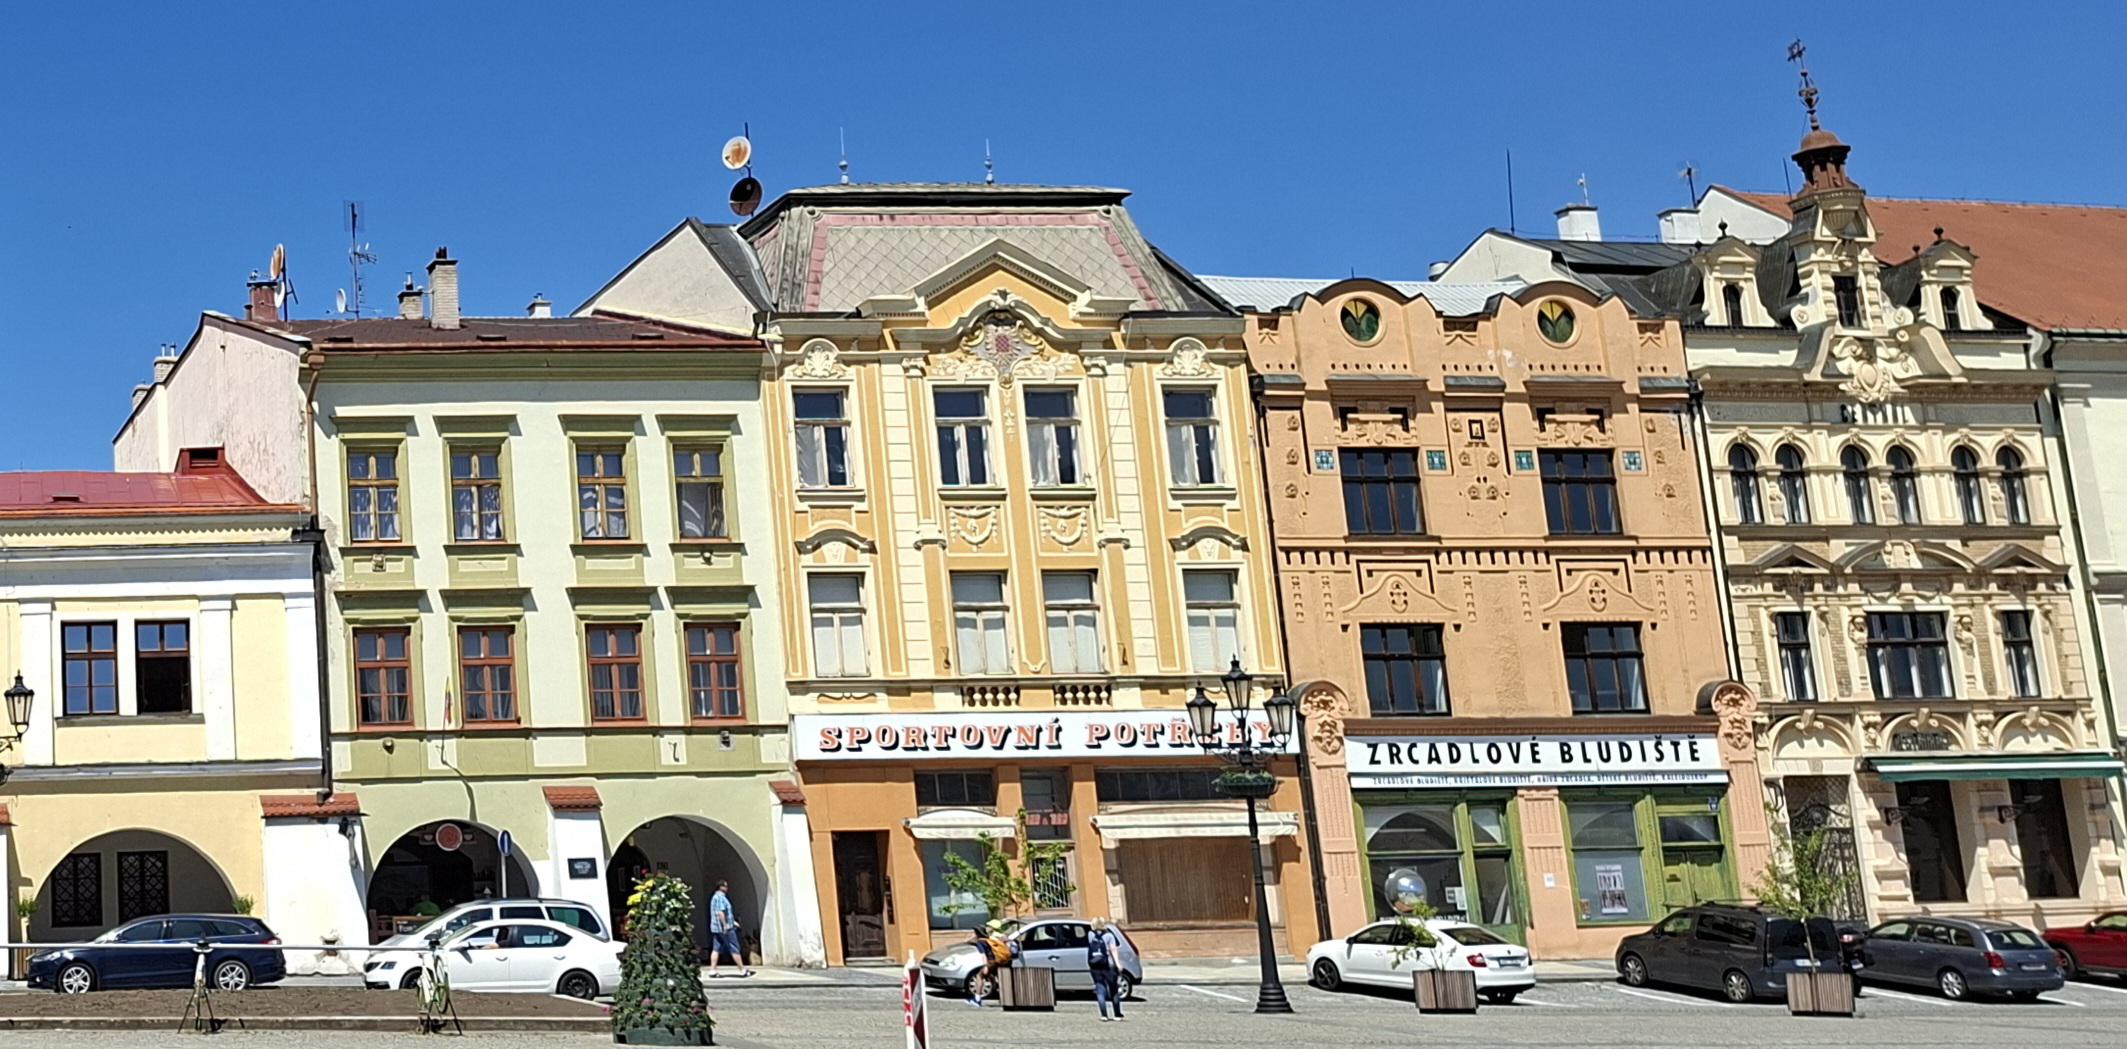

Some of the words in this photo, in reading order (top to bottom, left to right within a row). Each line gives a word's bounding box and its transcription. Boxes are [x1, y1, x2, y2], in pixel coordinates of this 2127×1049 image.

[818, 717, 1063, 752] SPORTOVNÍ
[1366, 736, 1542, 765] ZRCADLOVÉ
[1558, 734, 1701, 763] BLUDIŠTĚ
